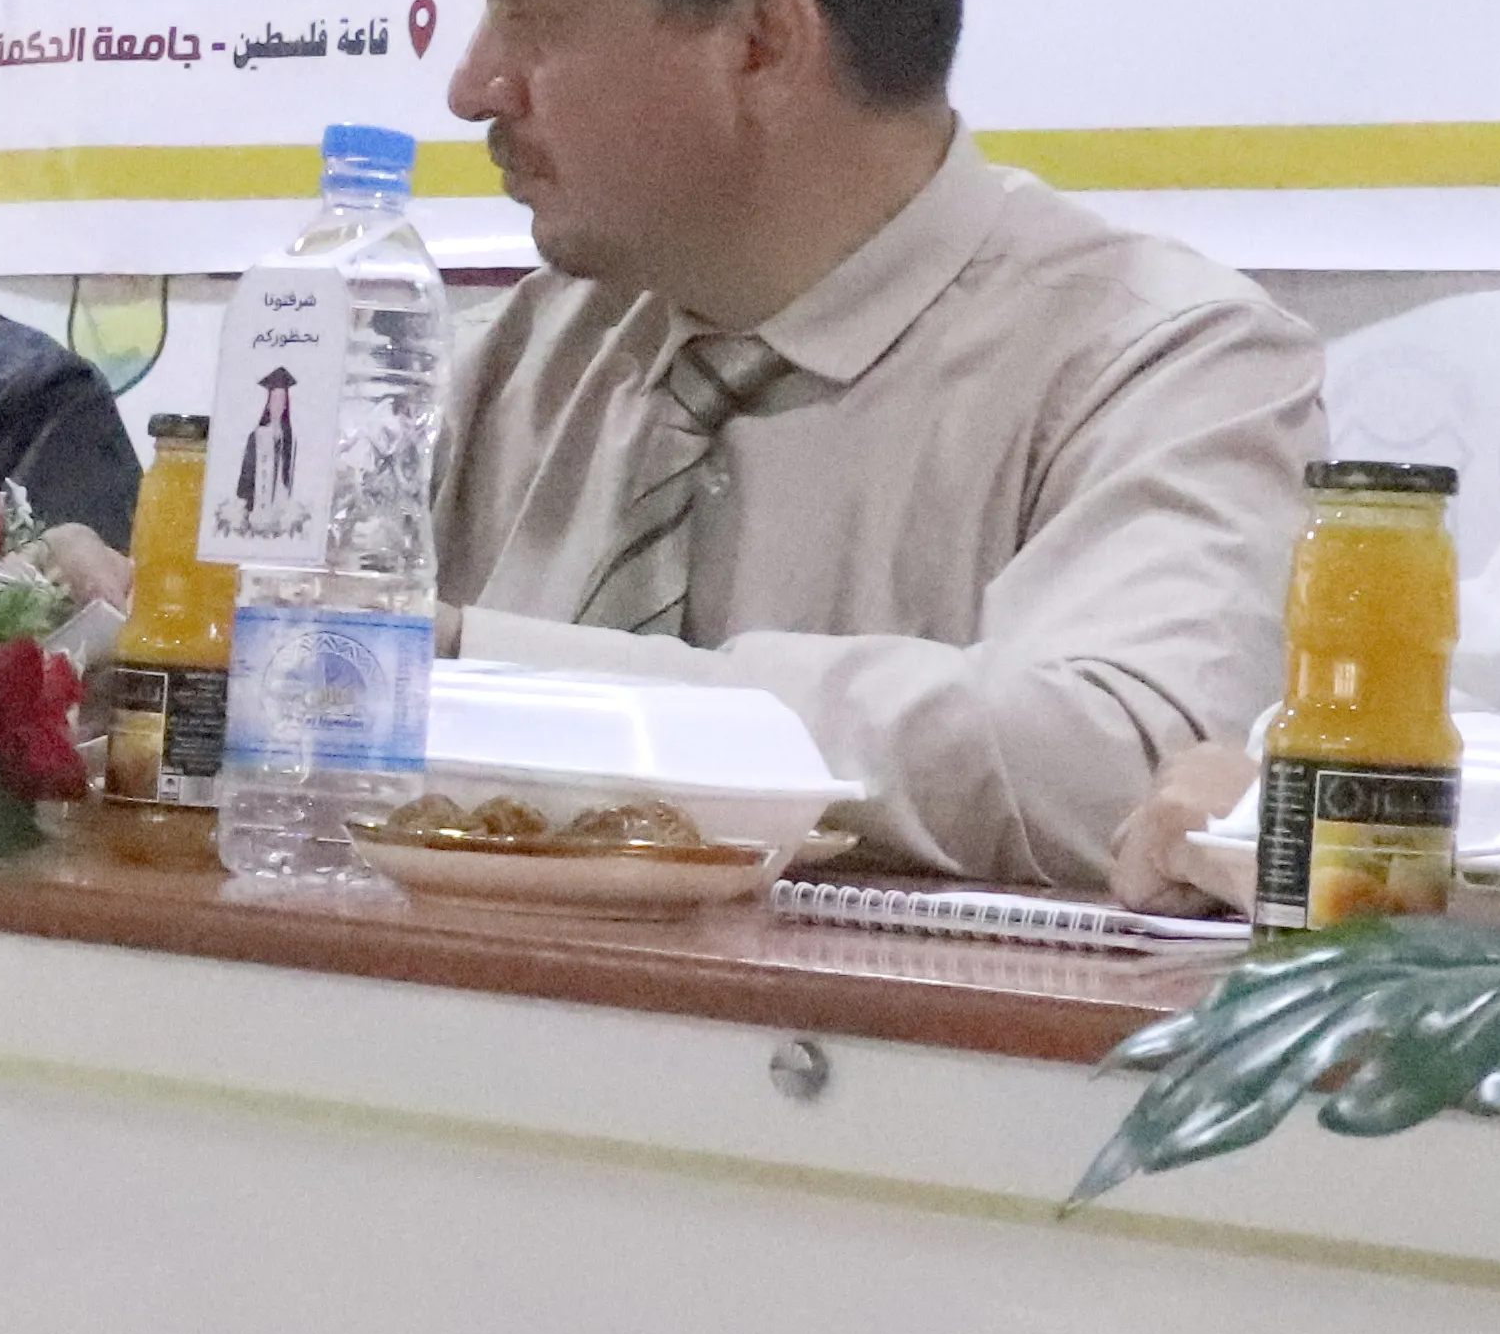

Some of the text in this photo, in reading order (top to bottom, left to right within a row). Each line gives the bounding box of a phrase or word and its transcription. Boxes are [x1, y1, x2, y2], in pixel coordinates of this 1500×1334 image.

[92, 25, 201, 69] جامعة
[233, 18, 328, 70] فلسطين
[337, 17, 389, 56] قاعة
[264, 292, 317, 312] شرفتونا
[252, 328, 320, 349] بحظوركم
